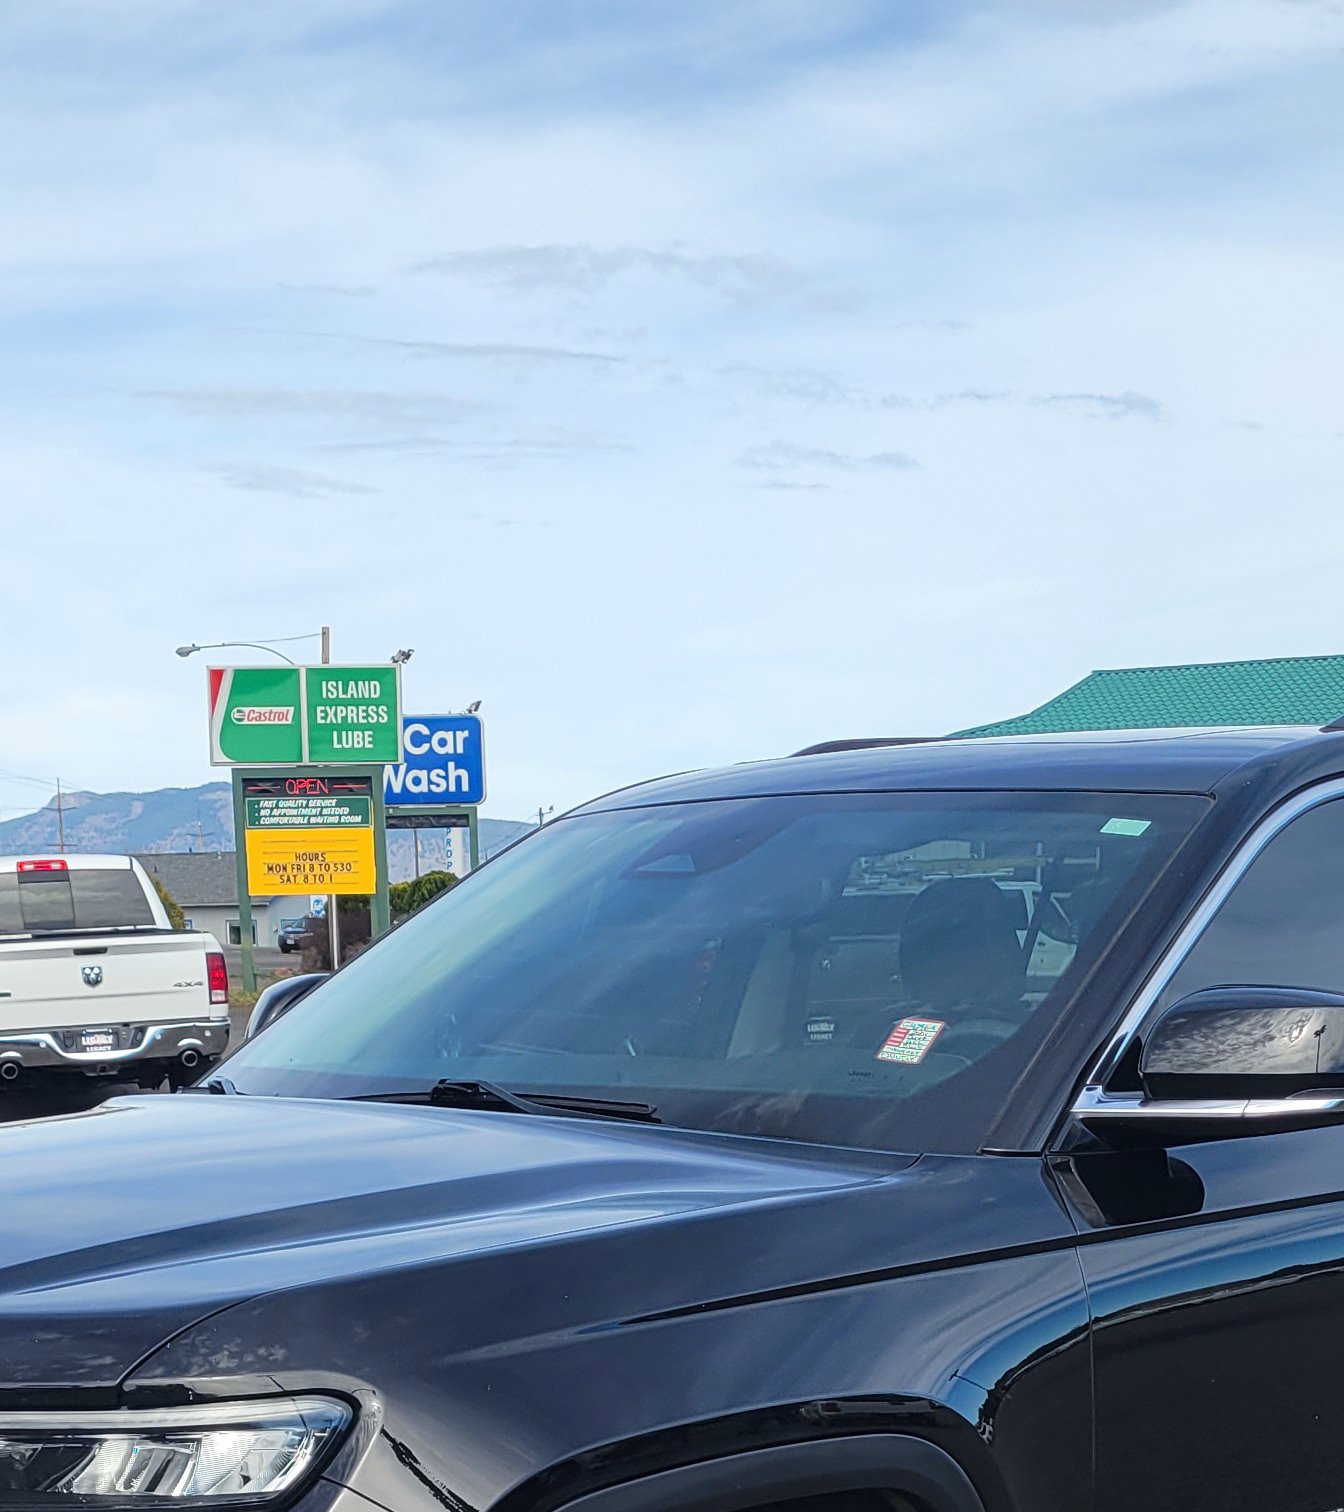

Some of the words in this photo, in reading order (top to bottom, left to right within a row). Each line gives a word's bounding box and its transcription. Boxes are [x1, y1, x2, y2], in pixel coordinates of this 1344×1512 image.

[321, 680, 381, 699] ISLAND
[247, 709, 290, 722] Castrol
[316, 705, 388, 724] EXPRESS
[332, 730, 374, 749] LUBE
[403, 723, 469, 755] Car
[382, 761, 470, 794] Wash
[284, 778, 330, 795] OPEN
[259, 800, 277, 808] FAST
[278, 799, 307, 808] QUALITY
[308, 799, 337, 807] SERVICE
[260, 808, 271, 816] NO
[271, 807, 320, 816] APPOINTMENT
[321, 807, 350, 815] NEEDED
[260, 816, 308, 824] COMFORTABLE
[309, 815, 339, 824] WAITING
[340, 815, 362, 823] ROOM
[294, 852, 327, 862] HOURS
[266, 863, 287, 873] MON
[290, 863, 306, 873] FRI
[308, 863, 315, 873] 8
[318, 863, 330, 872] TO
[333, 862, 352, 872] 530
[279, 875, 297, 884] SAT
[302, 874, 309, 884] 8
[313, 874, 325, 883] TO
